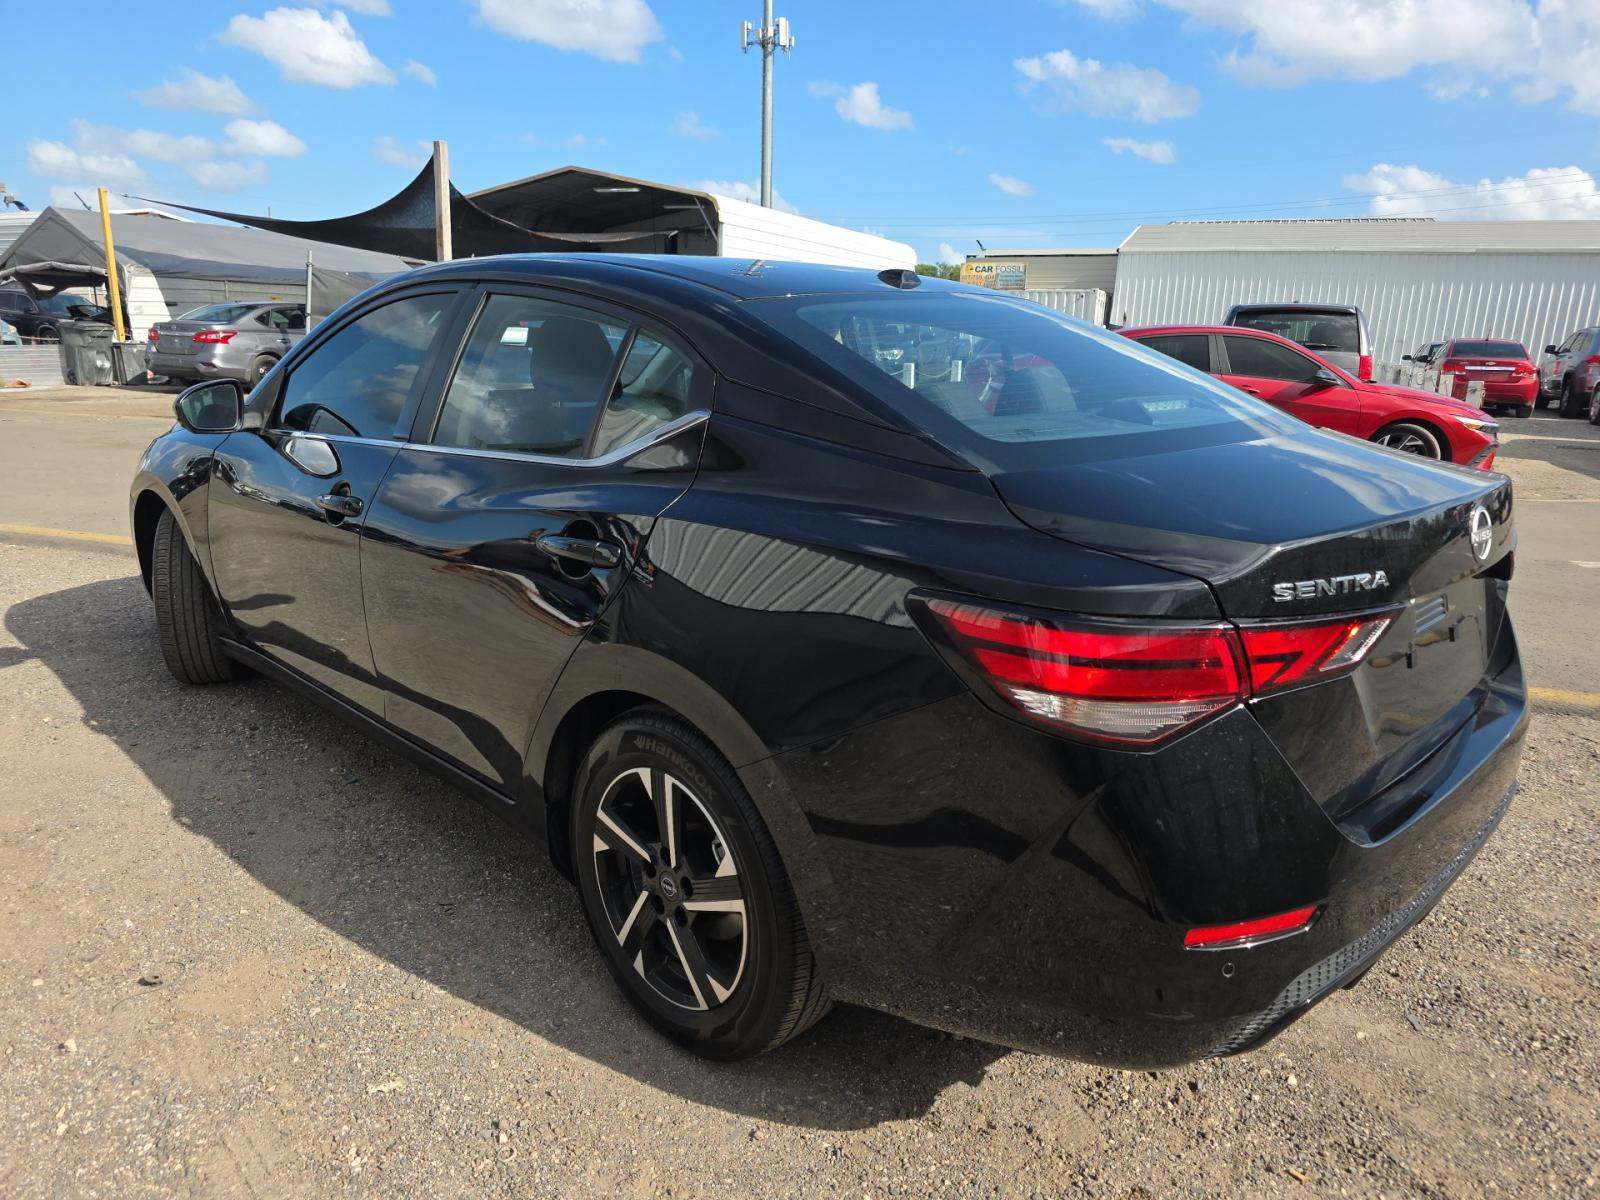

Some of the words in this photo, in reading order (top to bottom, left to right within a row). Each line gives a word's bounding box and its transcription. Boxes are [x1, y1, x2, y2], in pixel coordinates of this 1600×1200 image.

[974, 265, 993, 273] CAR
[995, 265, 1023, 273] FOSSIL
[1272, 570, 1390, 603] SENTRA
